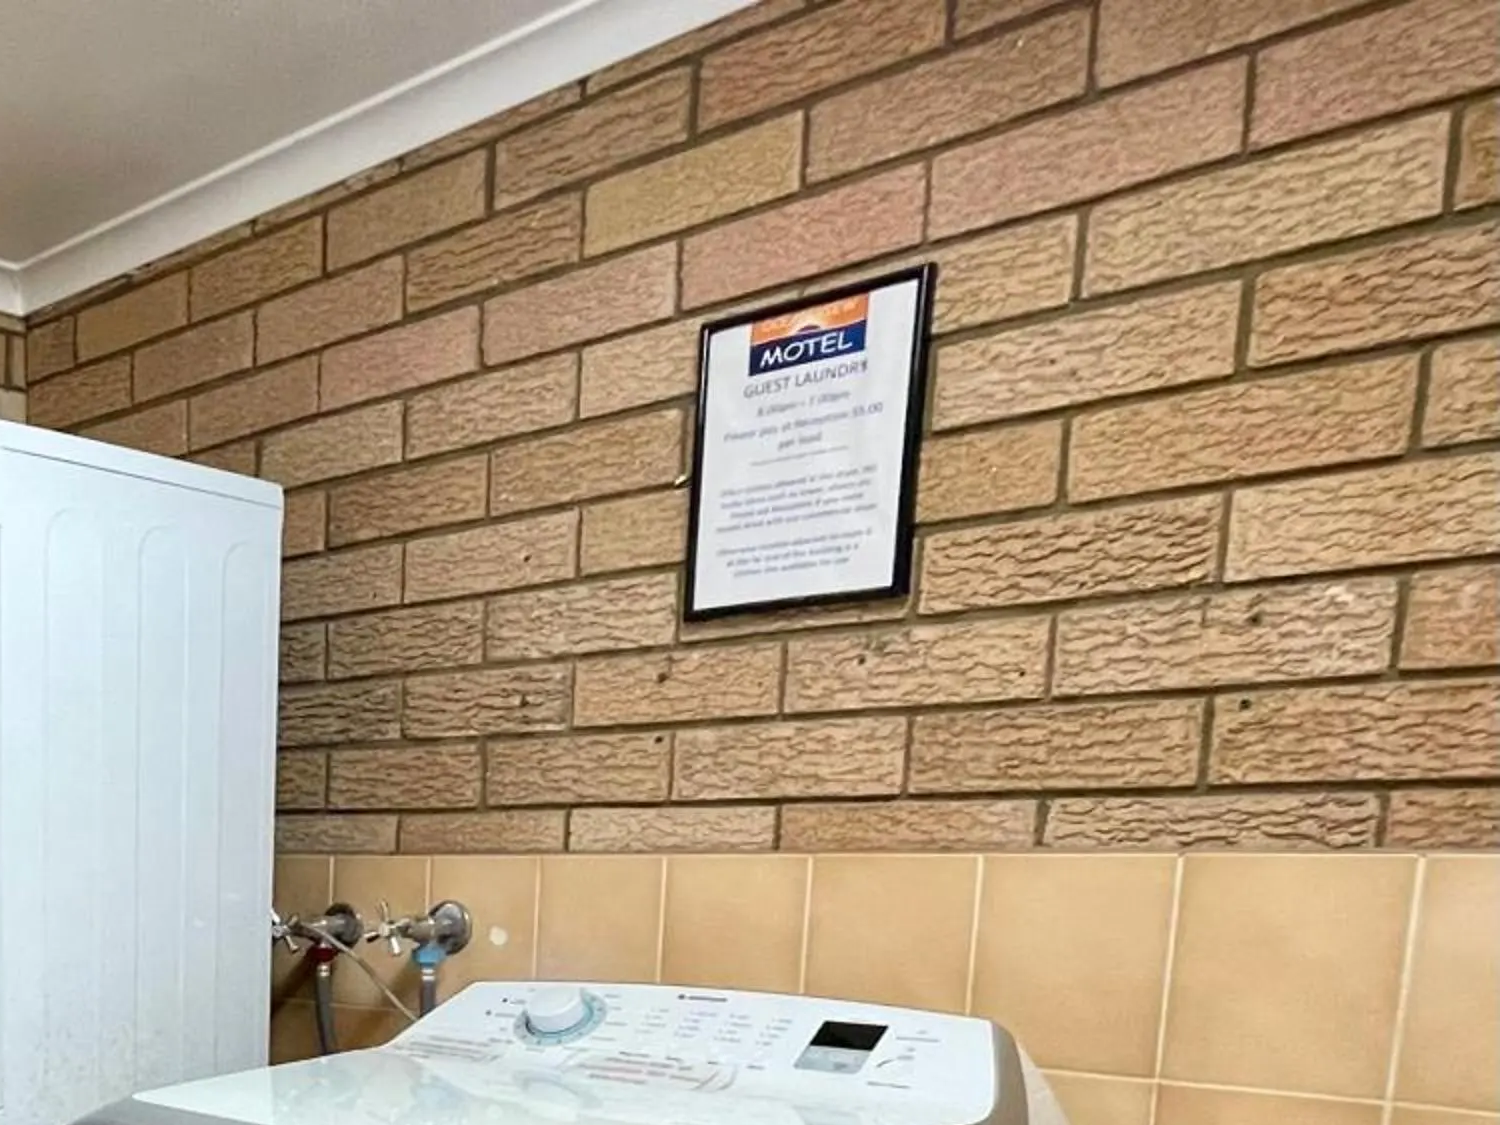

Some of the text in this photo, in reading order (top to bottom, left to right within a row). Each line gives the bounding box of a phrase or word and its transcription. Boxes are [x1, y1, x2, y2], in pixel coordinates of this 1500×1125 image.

[760, 332, 853, 369] MOTEL
[743, 360, 868, 399] GUEST LAUNDRY
